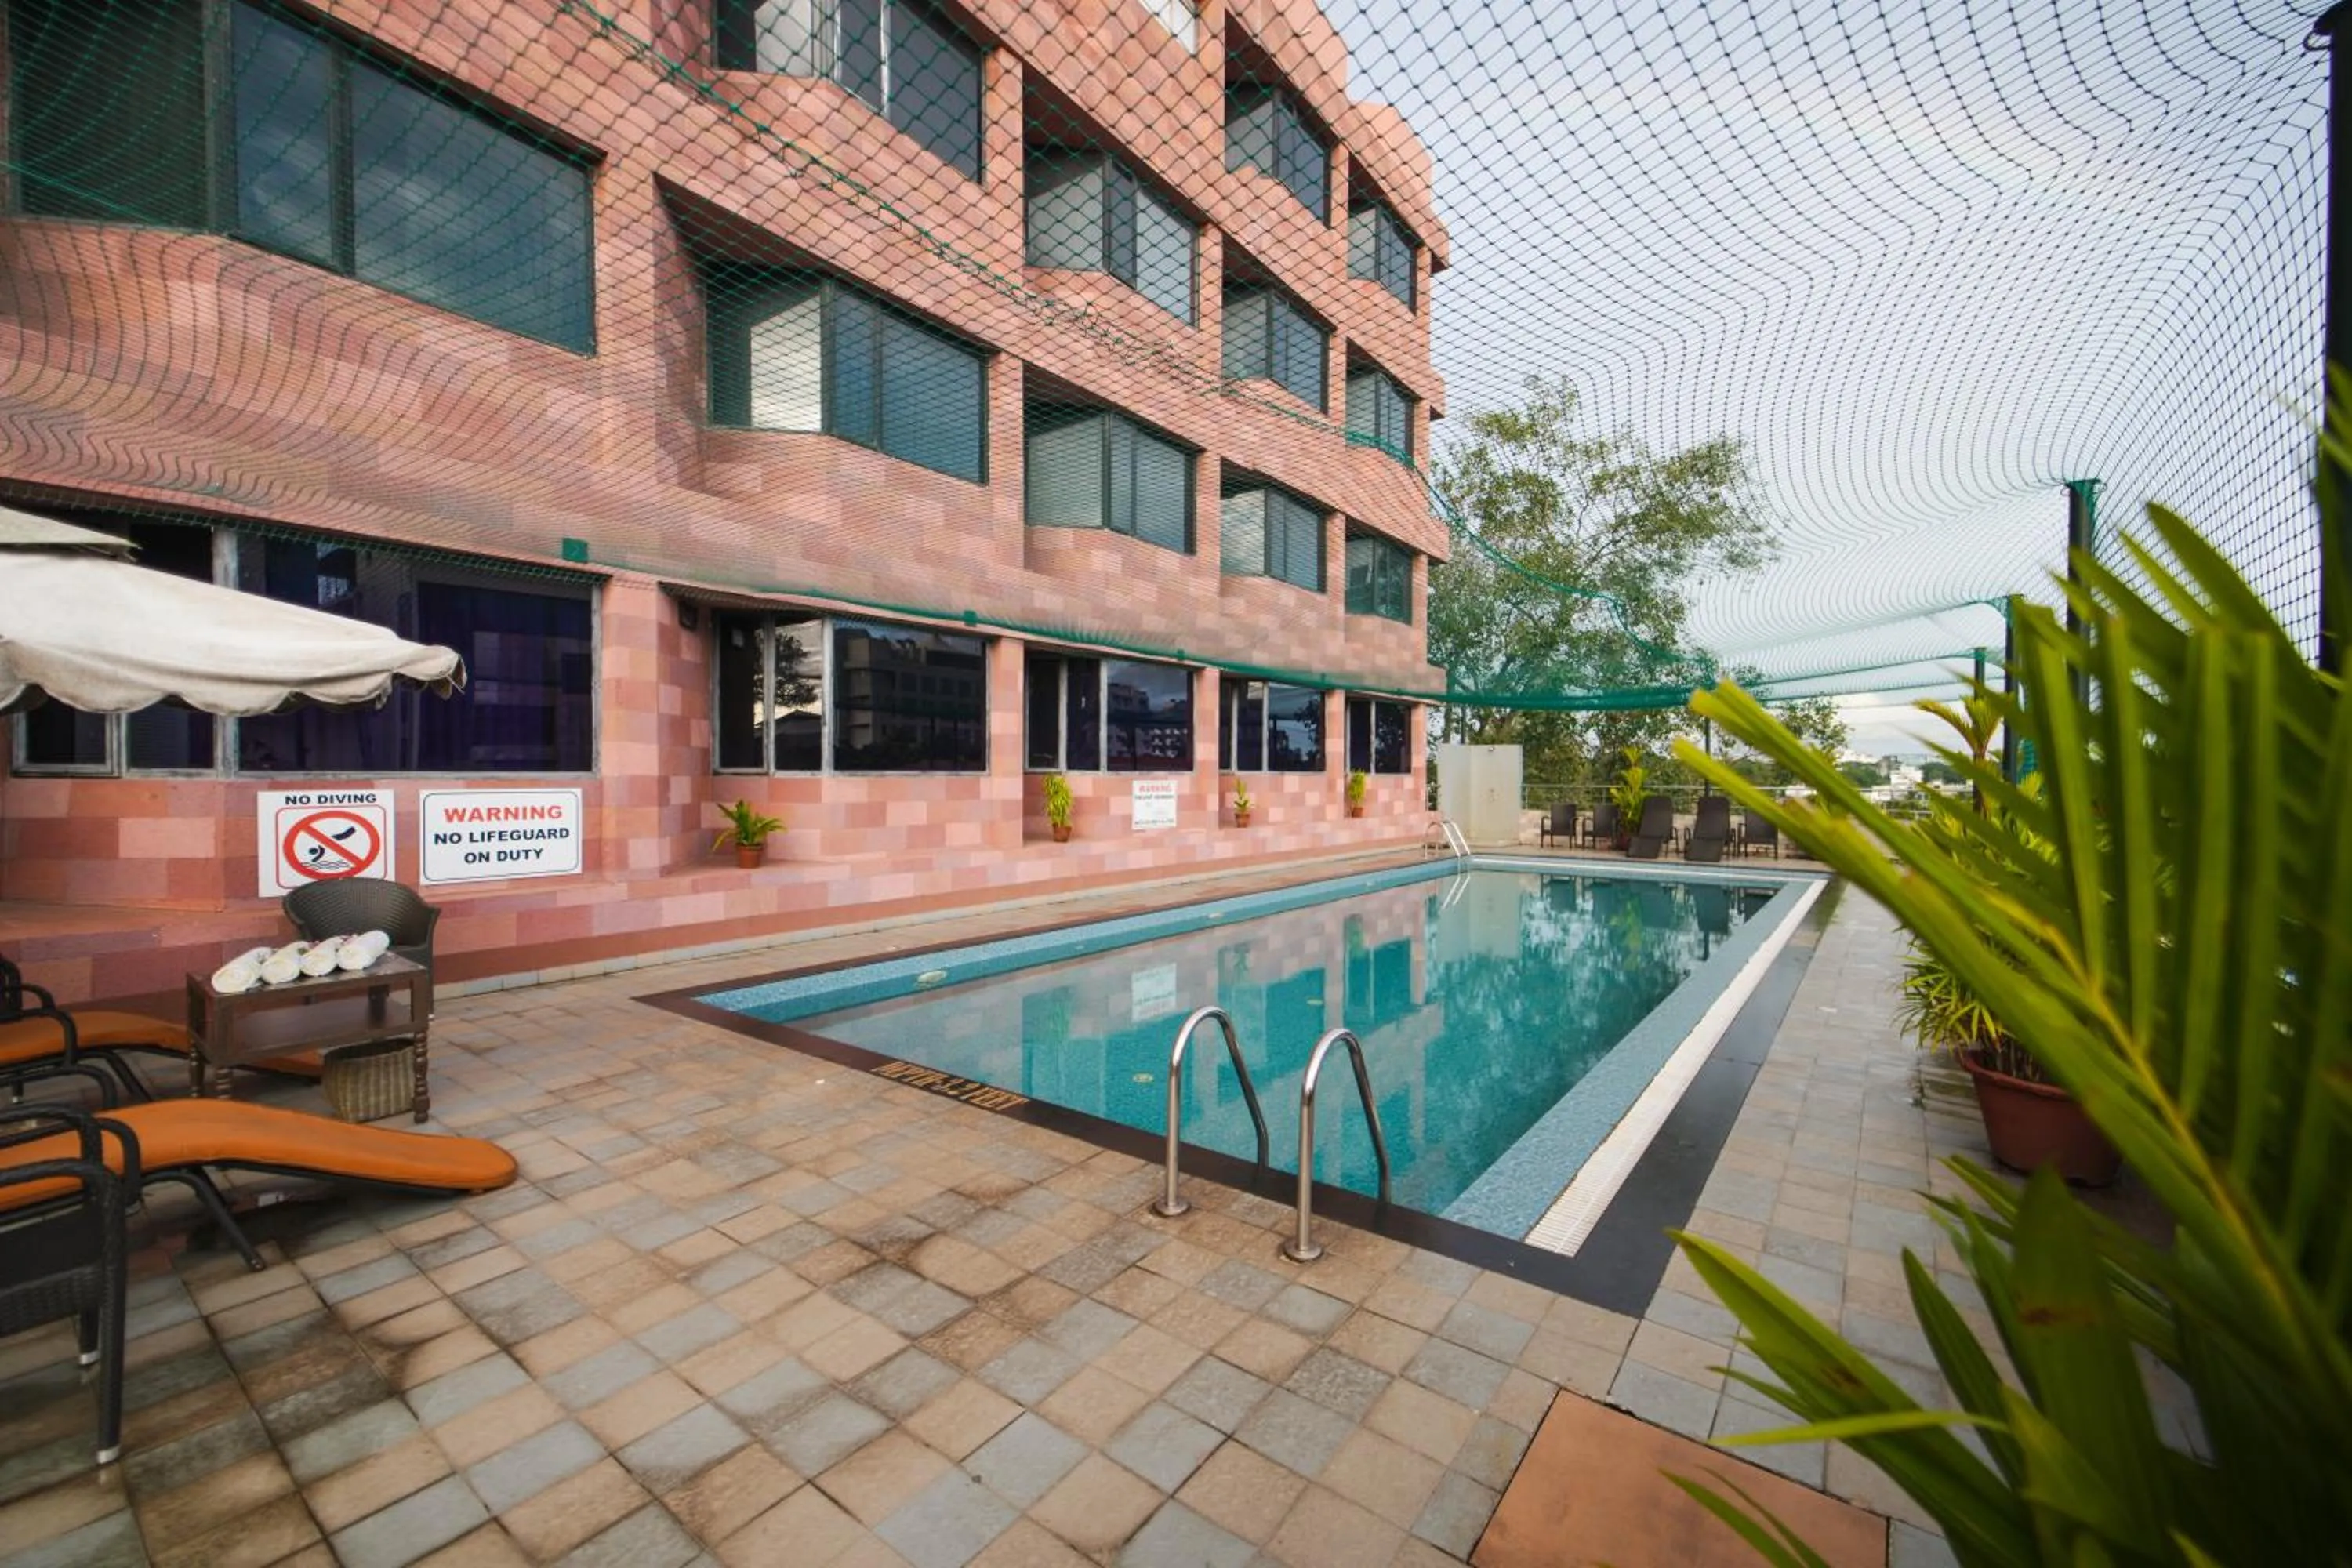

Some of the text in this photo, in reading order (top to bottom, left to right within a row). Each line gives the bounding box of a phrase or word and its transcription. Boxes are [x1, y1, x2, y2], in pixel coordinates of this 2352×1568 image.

[285, 793, 377, 804] NO DIVING
[444, 805, 563, 822] WARNING
[434, 827, 570, 845] NO LIFEGUARD
[464, 848, 543, 863] ON DUTY
